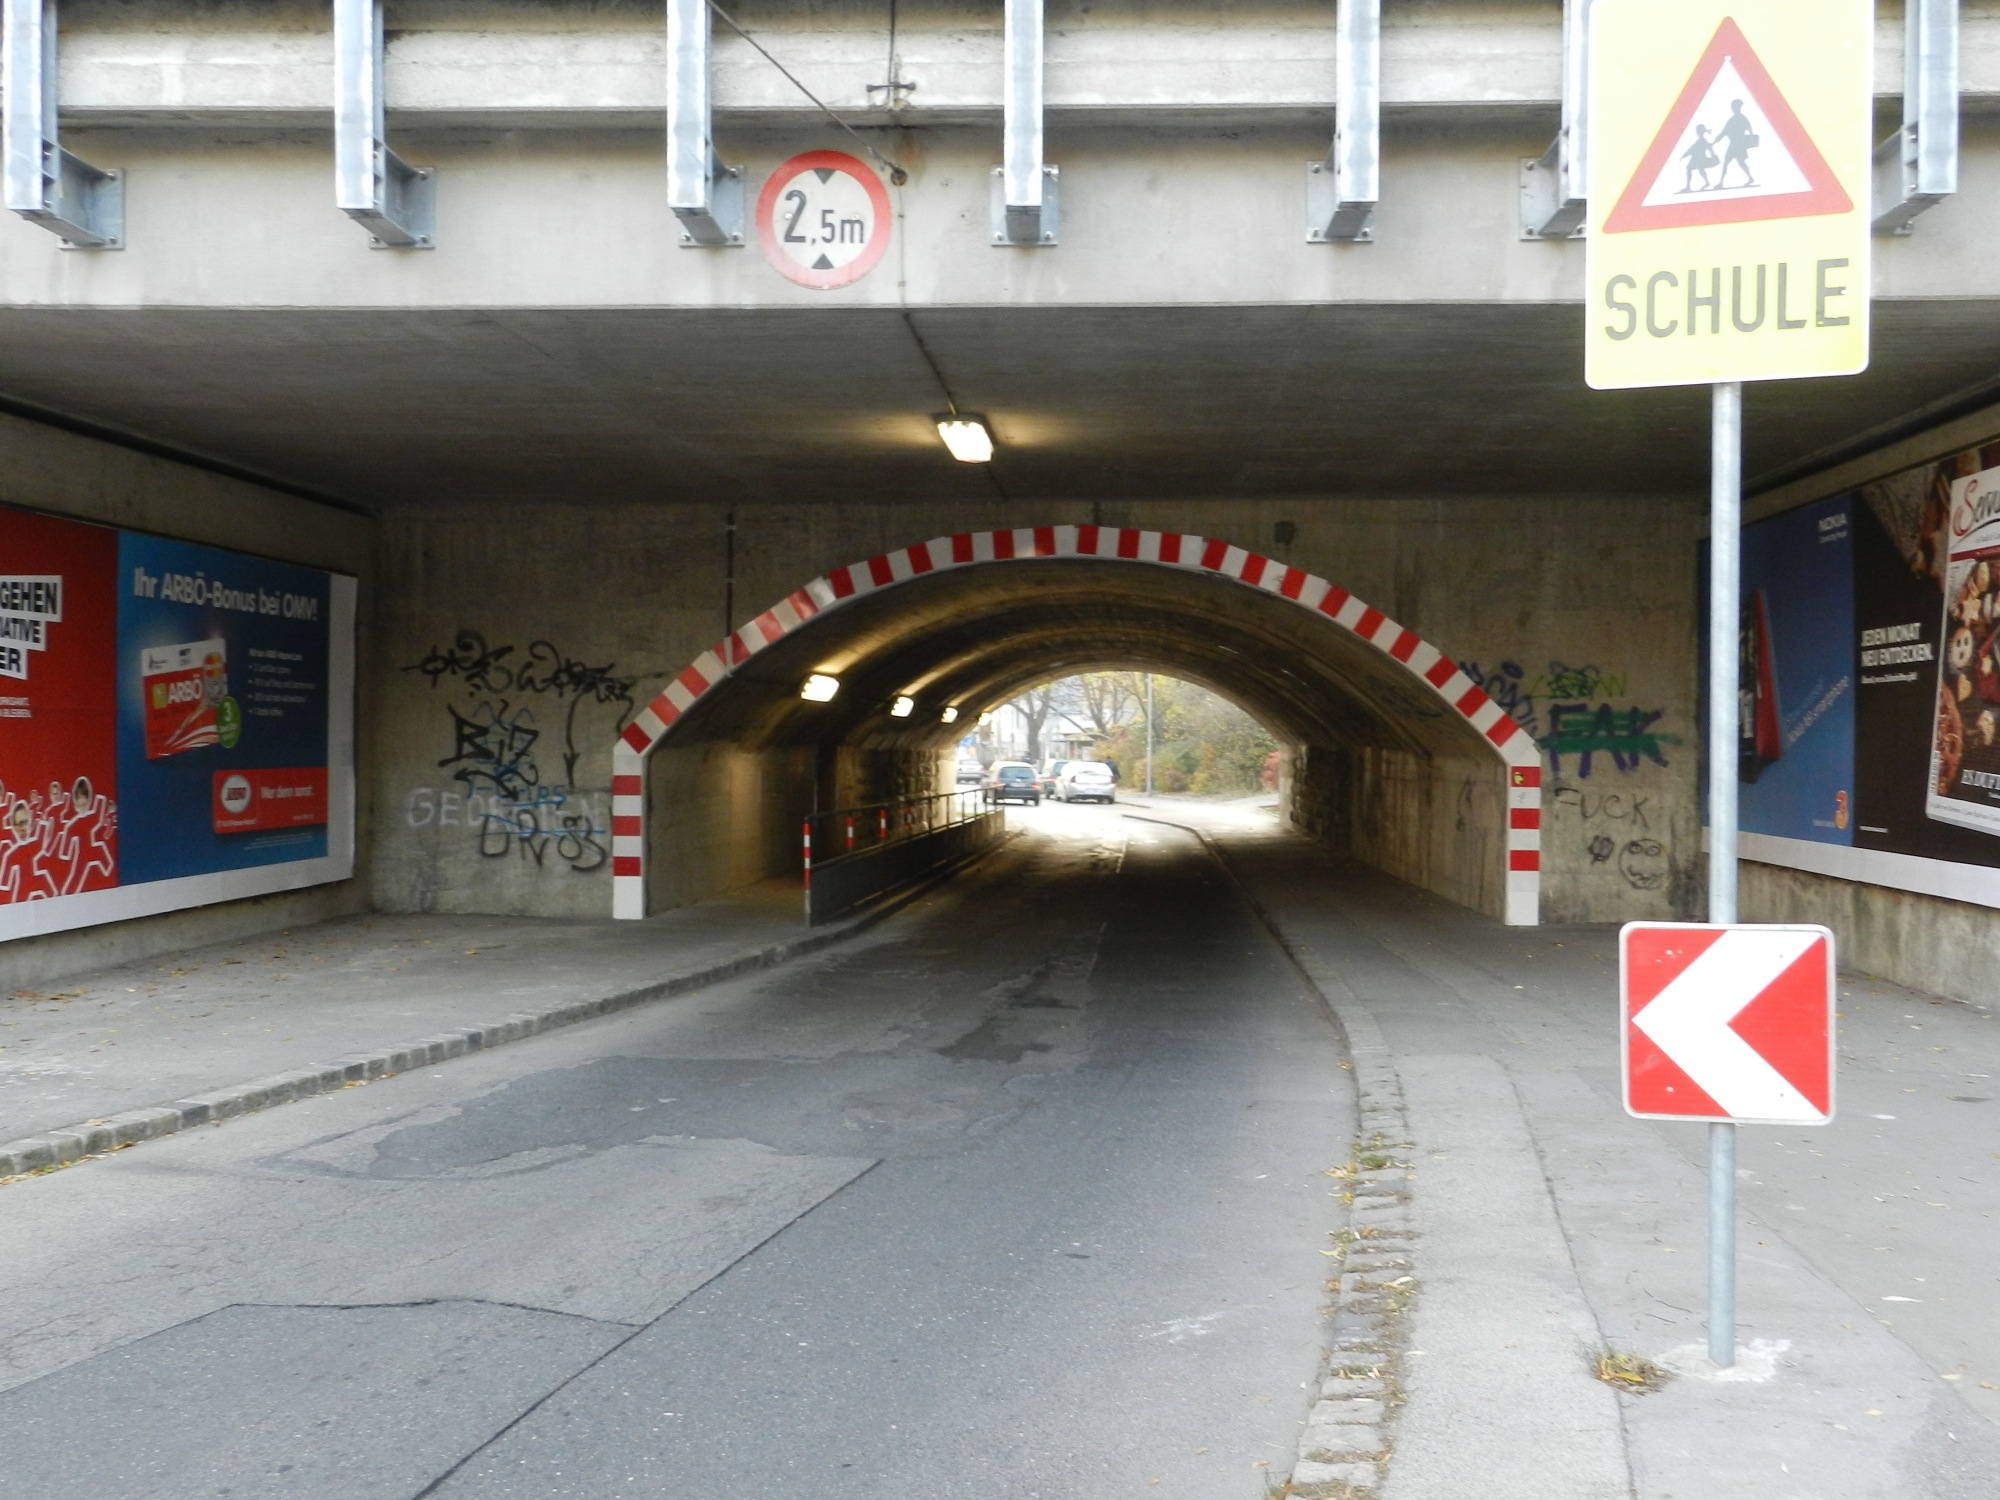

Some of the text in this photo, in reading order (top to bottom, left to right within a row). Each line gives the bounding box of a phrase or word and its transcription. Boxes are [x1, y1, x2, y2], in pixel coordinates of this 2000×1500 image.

[784, 189, 864, 245] 2,5m
[1604, 258, 1850, 341] SCHULE
[134, 567, 157, 598] Ihr
[160, 571, 258, 613] ARBÖ-Bonus
[259, 587, 280, 615] bei
[168, 673, 203, 704] ARBÖ
[1554, 787, 1649, 829] FUCK
